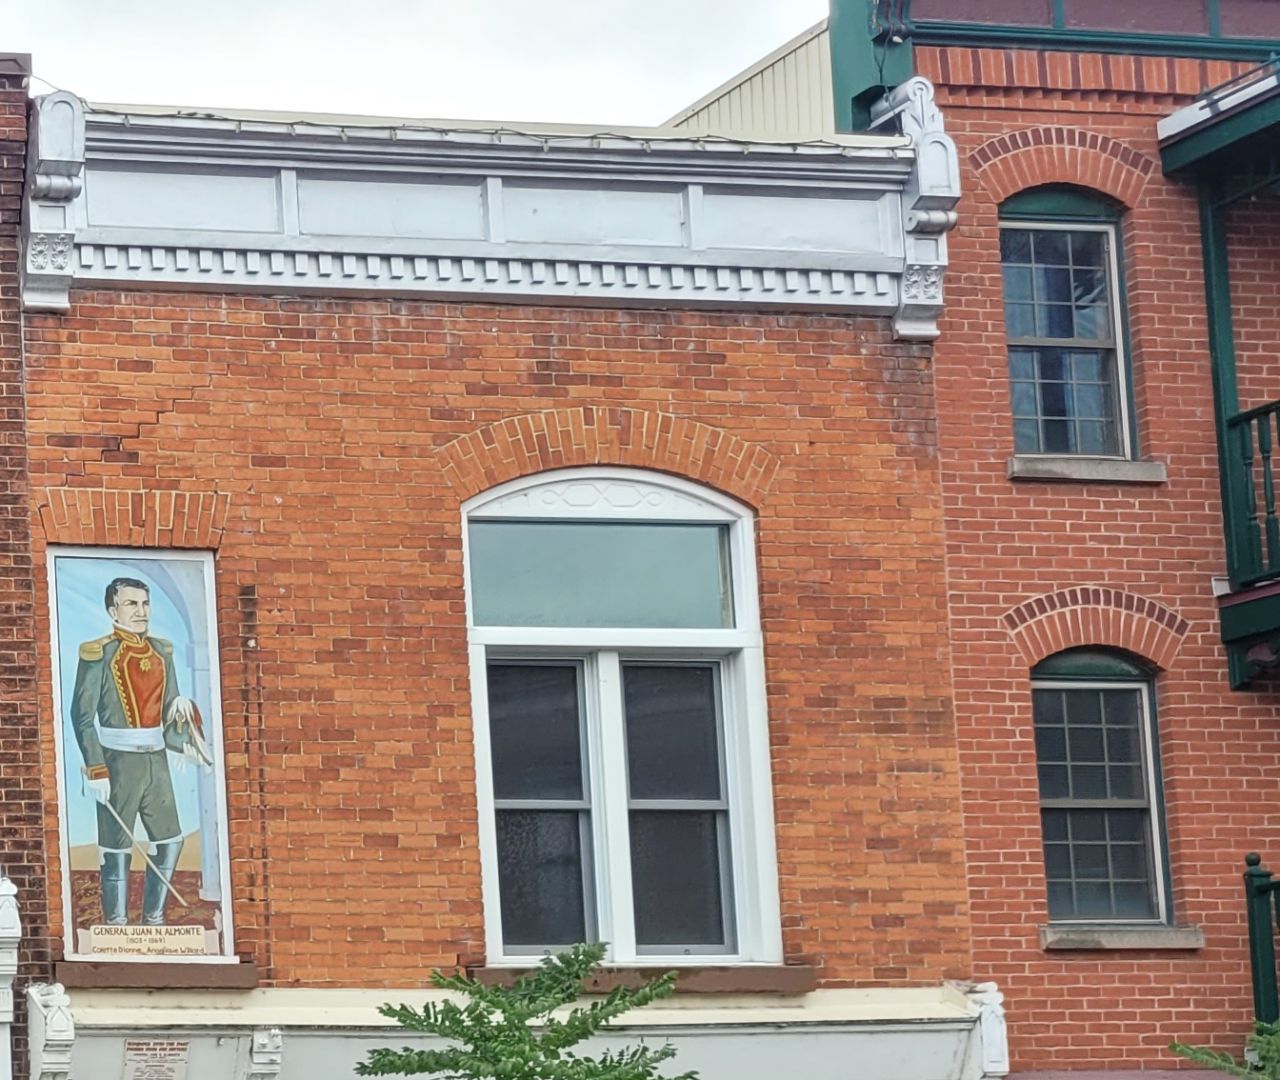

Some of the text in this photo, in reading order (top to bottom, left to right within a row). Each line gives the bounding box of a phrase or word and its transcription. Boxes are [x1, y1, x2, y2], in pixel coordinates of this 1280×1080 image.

[94, 927, 128, 936] GENERAL
[131, 927, 152, 936] JUAN
[165, 927, 201, 936] ALMONTE
